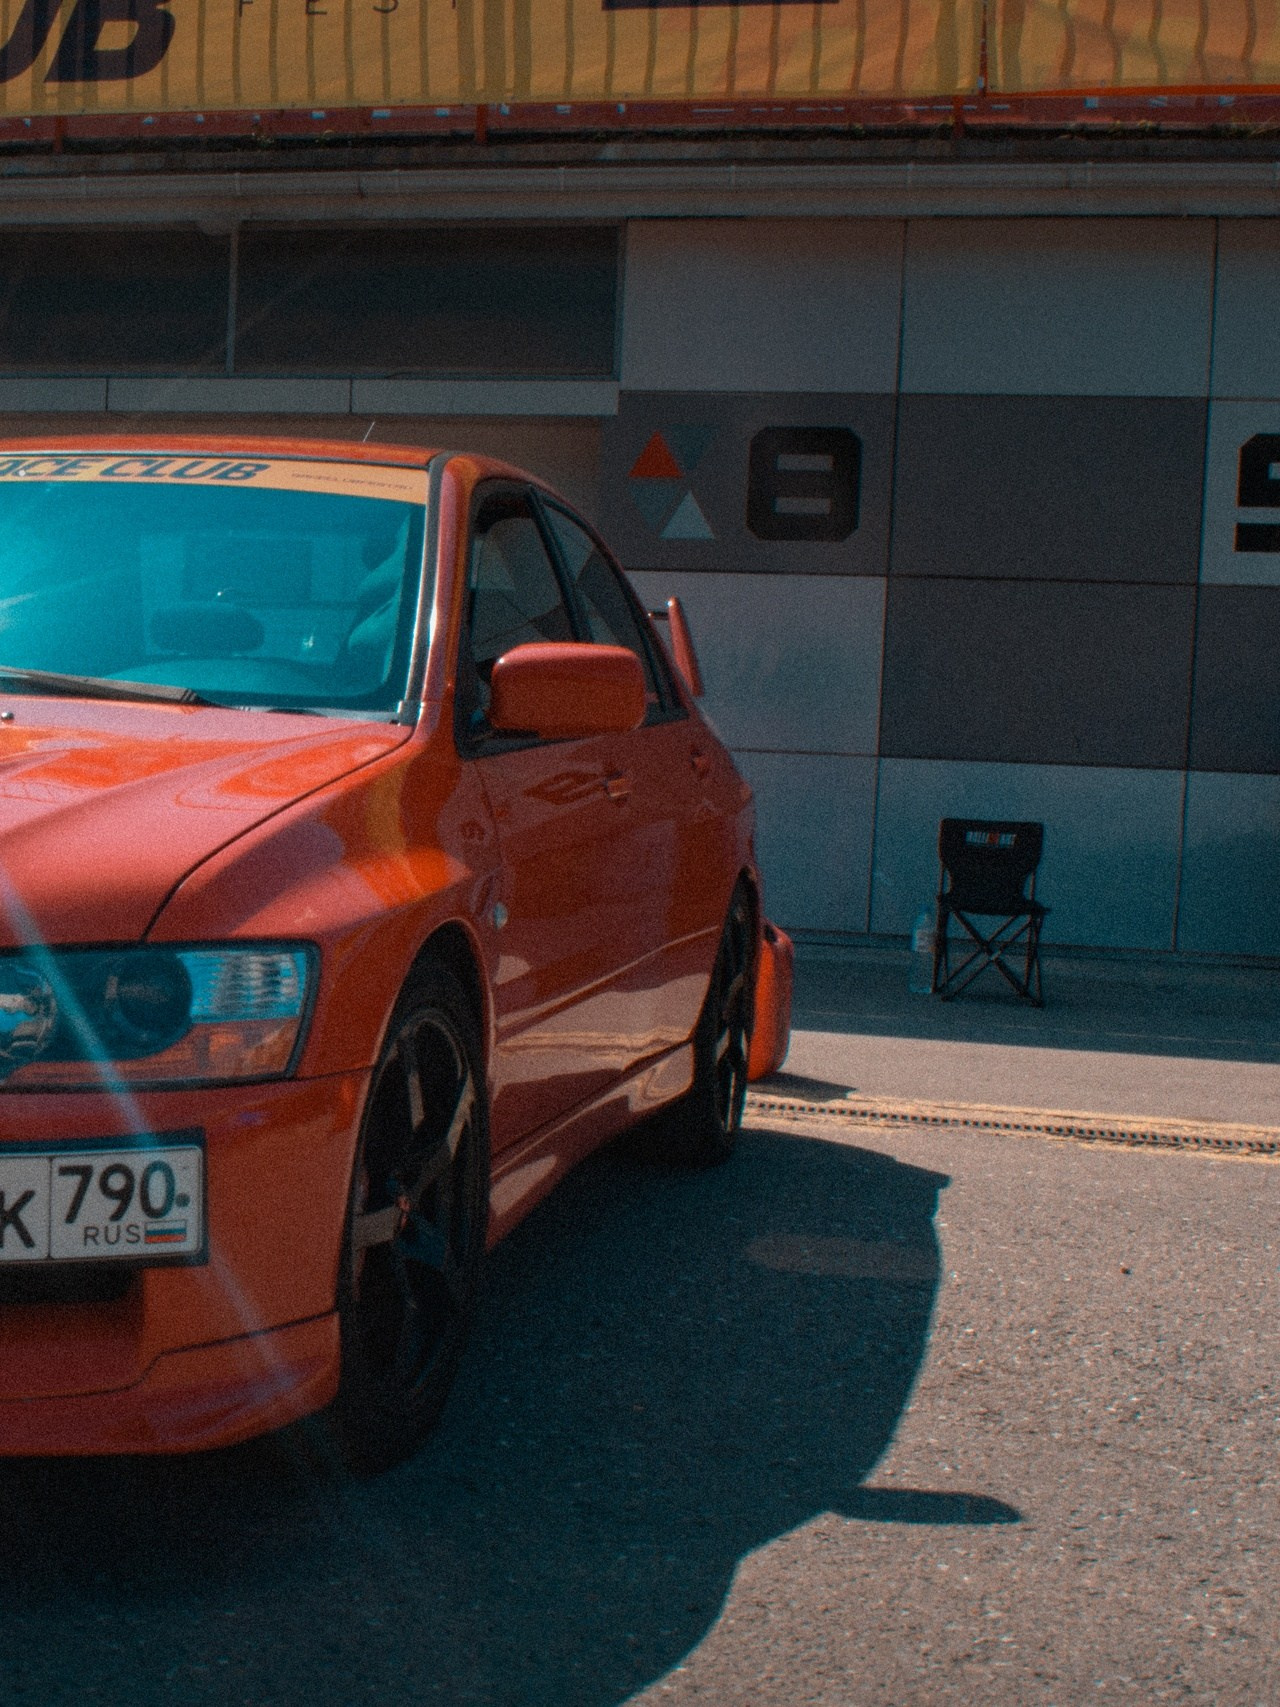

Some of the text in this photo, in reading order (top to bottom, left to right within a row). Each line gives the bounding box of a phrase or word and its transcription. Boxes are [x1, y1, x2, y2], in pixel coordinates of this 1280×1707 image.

[100, 457, 271, 481] CLUB
[745, 426, 863, 543] 8
[58, 1159, 176, 1225] 790
[83, 1223, 141, 1247] RUS
